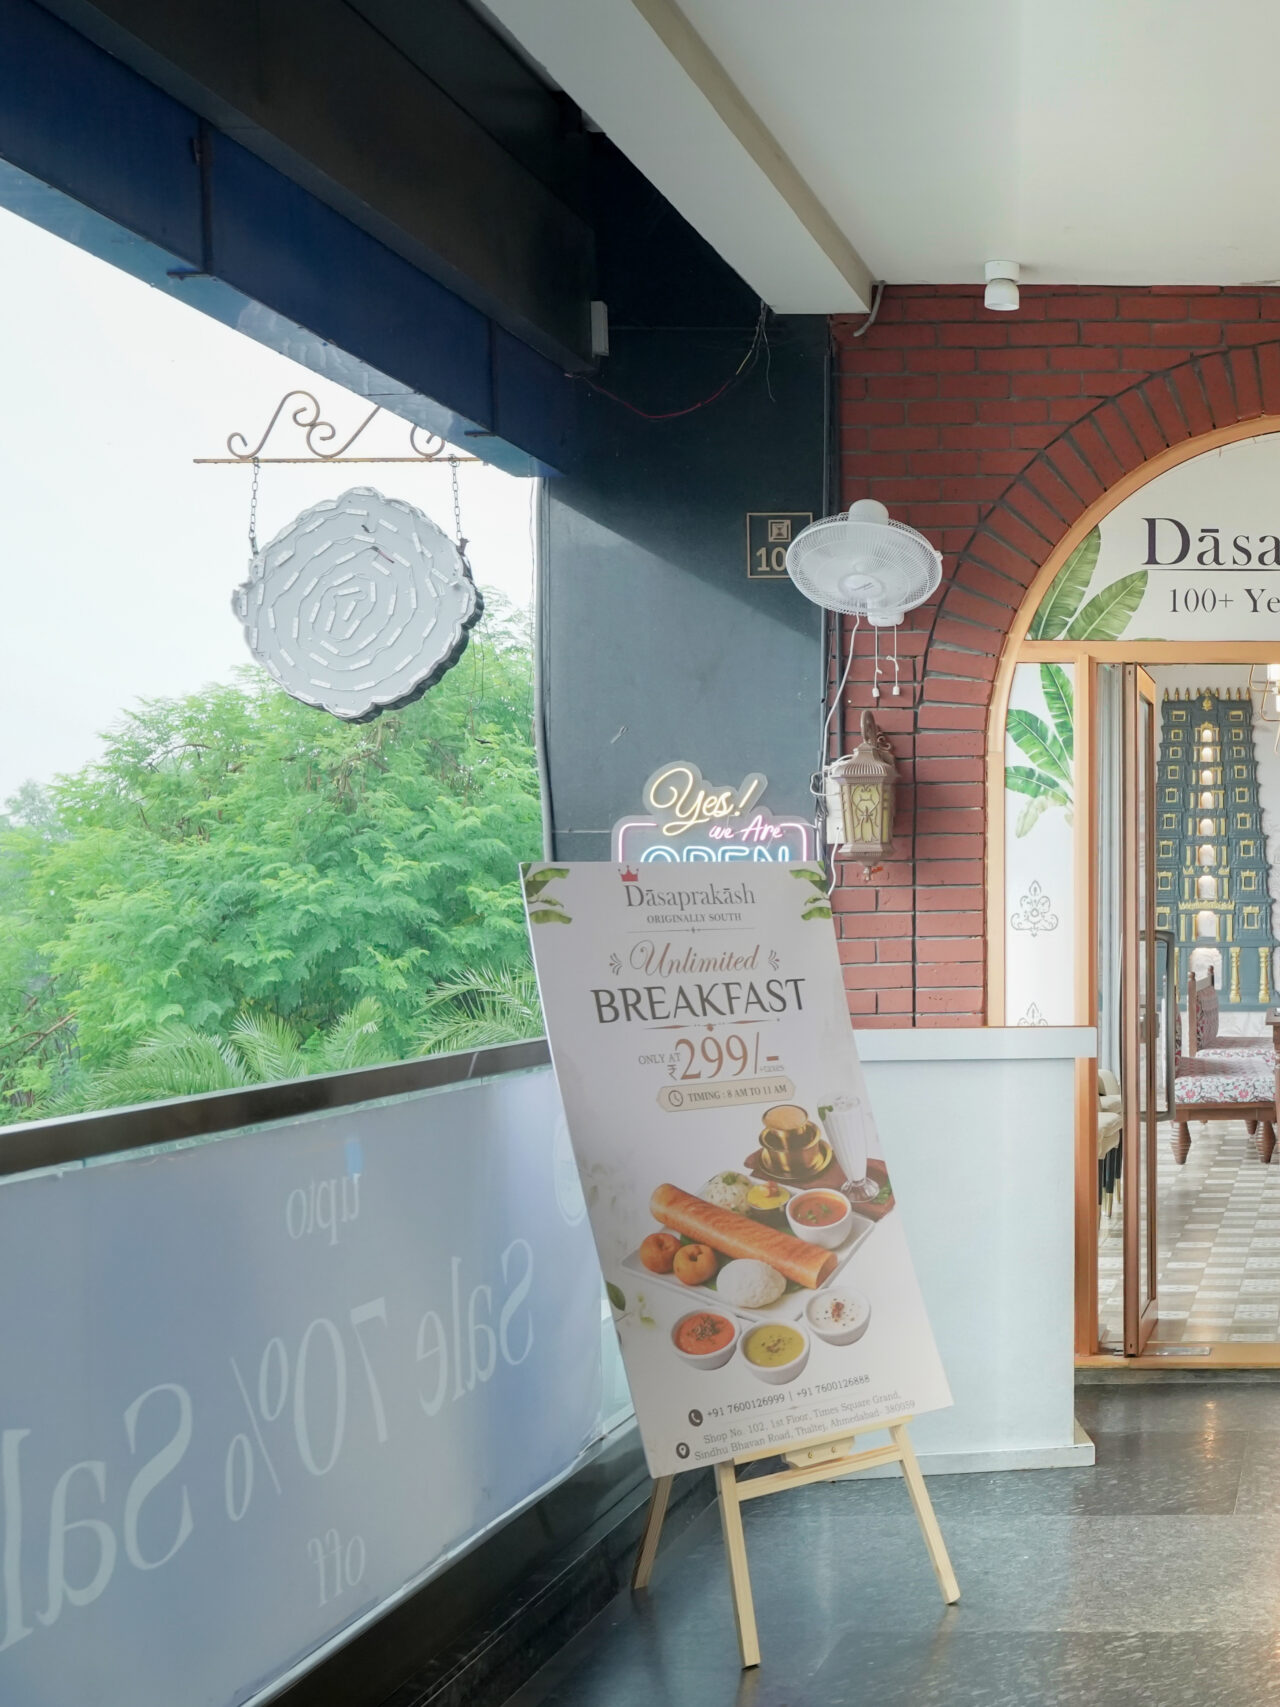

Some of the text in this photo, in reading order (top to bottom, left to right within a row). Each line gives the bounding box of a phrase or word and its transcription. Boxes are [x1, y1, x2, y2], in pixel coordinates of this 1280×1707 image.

[756, 547, 788, 572] 10
[1168, 588, 1234, 614] 100+
[650, 767, 760, 836] Yes!
[709, 814, 783, 842] we Are
[624, 883, 757, 911] Dāsaprakāsh
[646, 912, 743, 925] ORIGINALLY SOUTH
[629, 939, 760, 978] Unlimited
[590, 978, 805, 1024] BREAKFAST
[638, 1052, 681, 1065] ONLY AT
[688, 1090, 720, 1103] TIMING
[734, 1087, 748, 1097] AM
[748, 1087, 761, 1096] TO
[774, 1084, 788, 1094] AM
[707, 1402, 724, 1417] +91
[727, 1393, 785, 1413] 7600126999
[797, 1382, 813, 1397] +91
[816, 1374, 871, 1394] 7600126888
[703, 1431, 728, 1445] Shop
[771, 1417, 785, 1430] 1st
[813, 1405, 840, 1419] Times
[840, 1398, 871, 1413] Square
[694, 1445, 729, 1461] Sindhu
[730, 1437, 766, 1454] Bhavan
